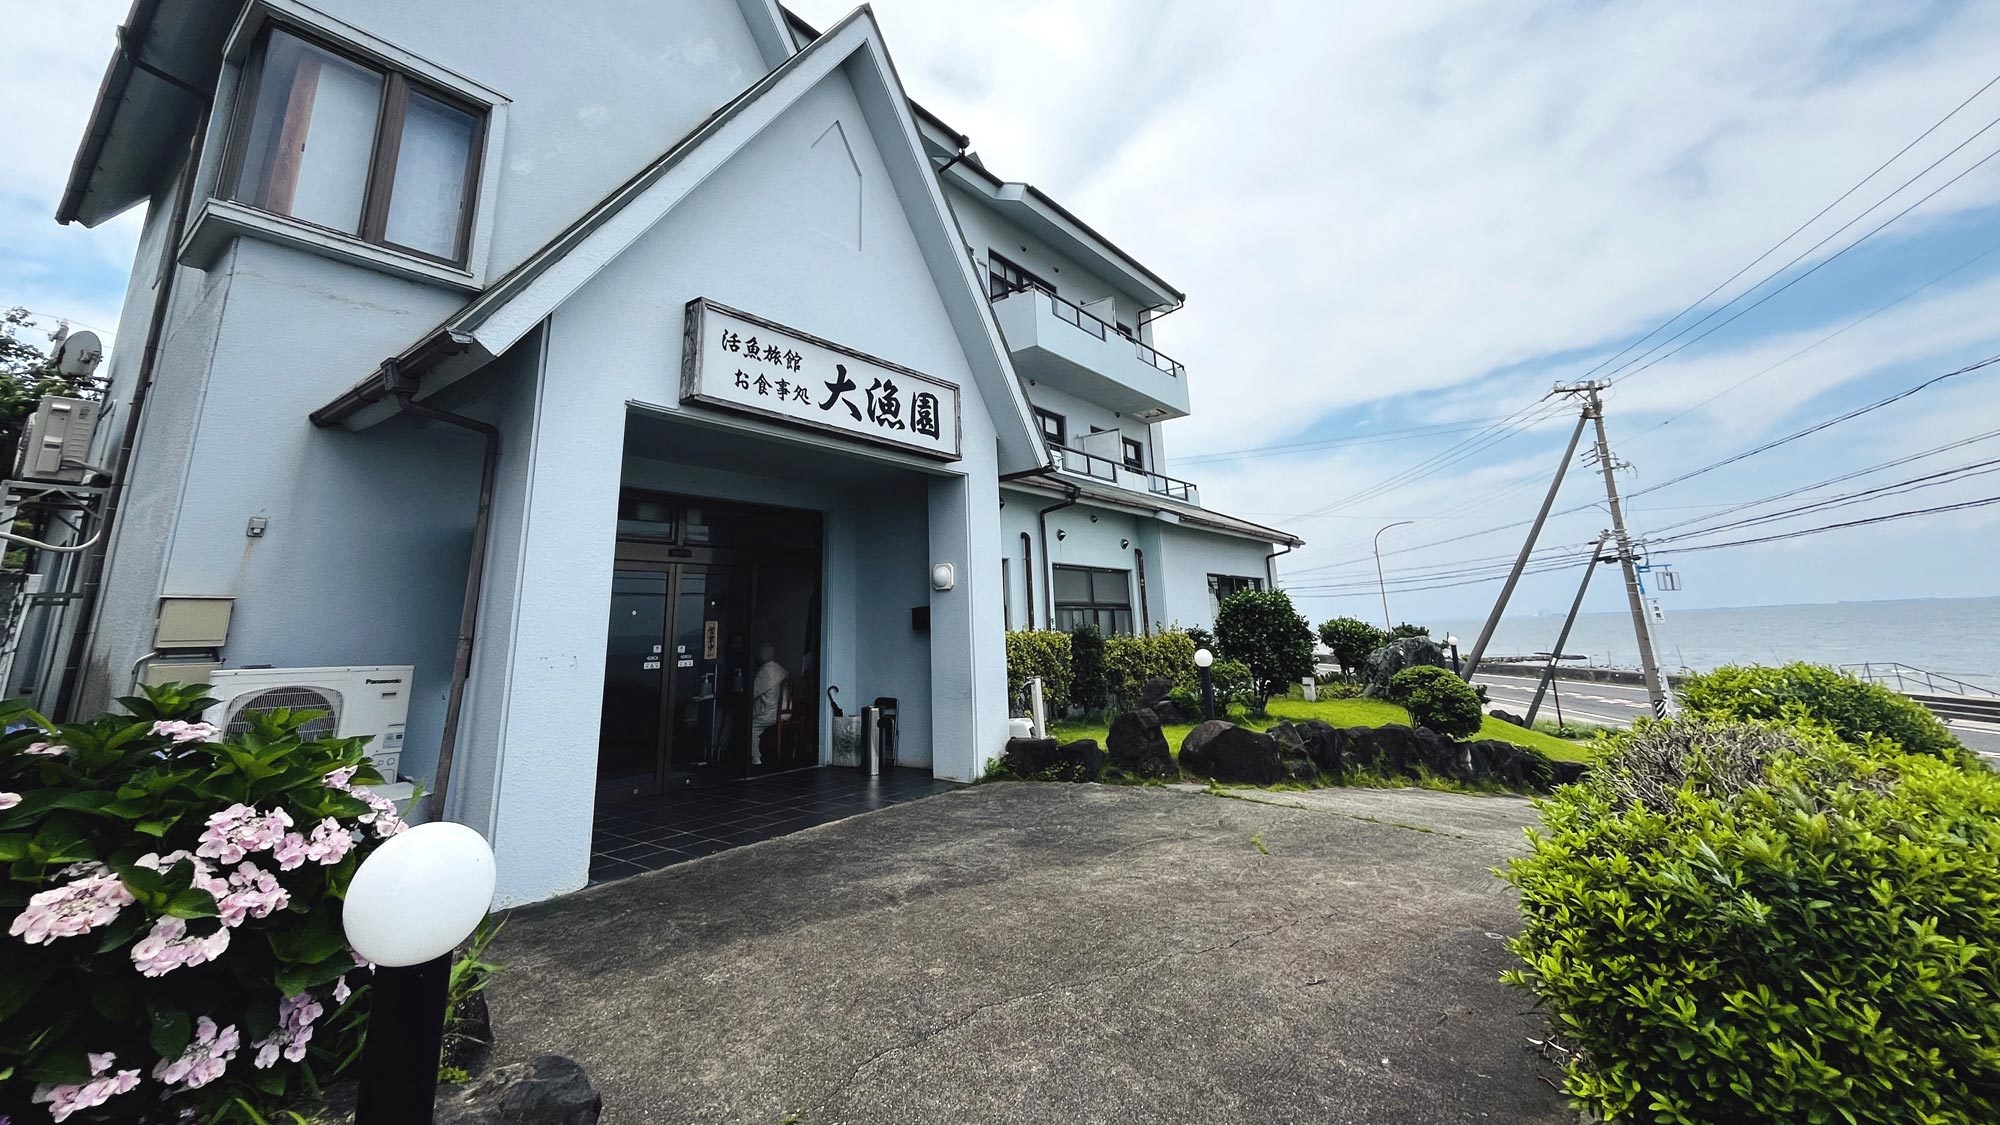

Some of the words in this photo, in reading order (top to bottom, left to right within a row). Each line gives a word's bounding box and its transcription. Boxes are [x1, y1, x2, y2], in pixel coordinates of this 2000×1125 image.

[721, 329, 803, 372] 活魚旅館
[734, 369, 812, 405] お食事処
[818, 364, 940, 440] 大漁園
